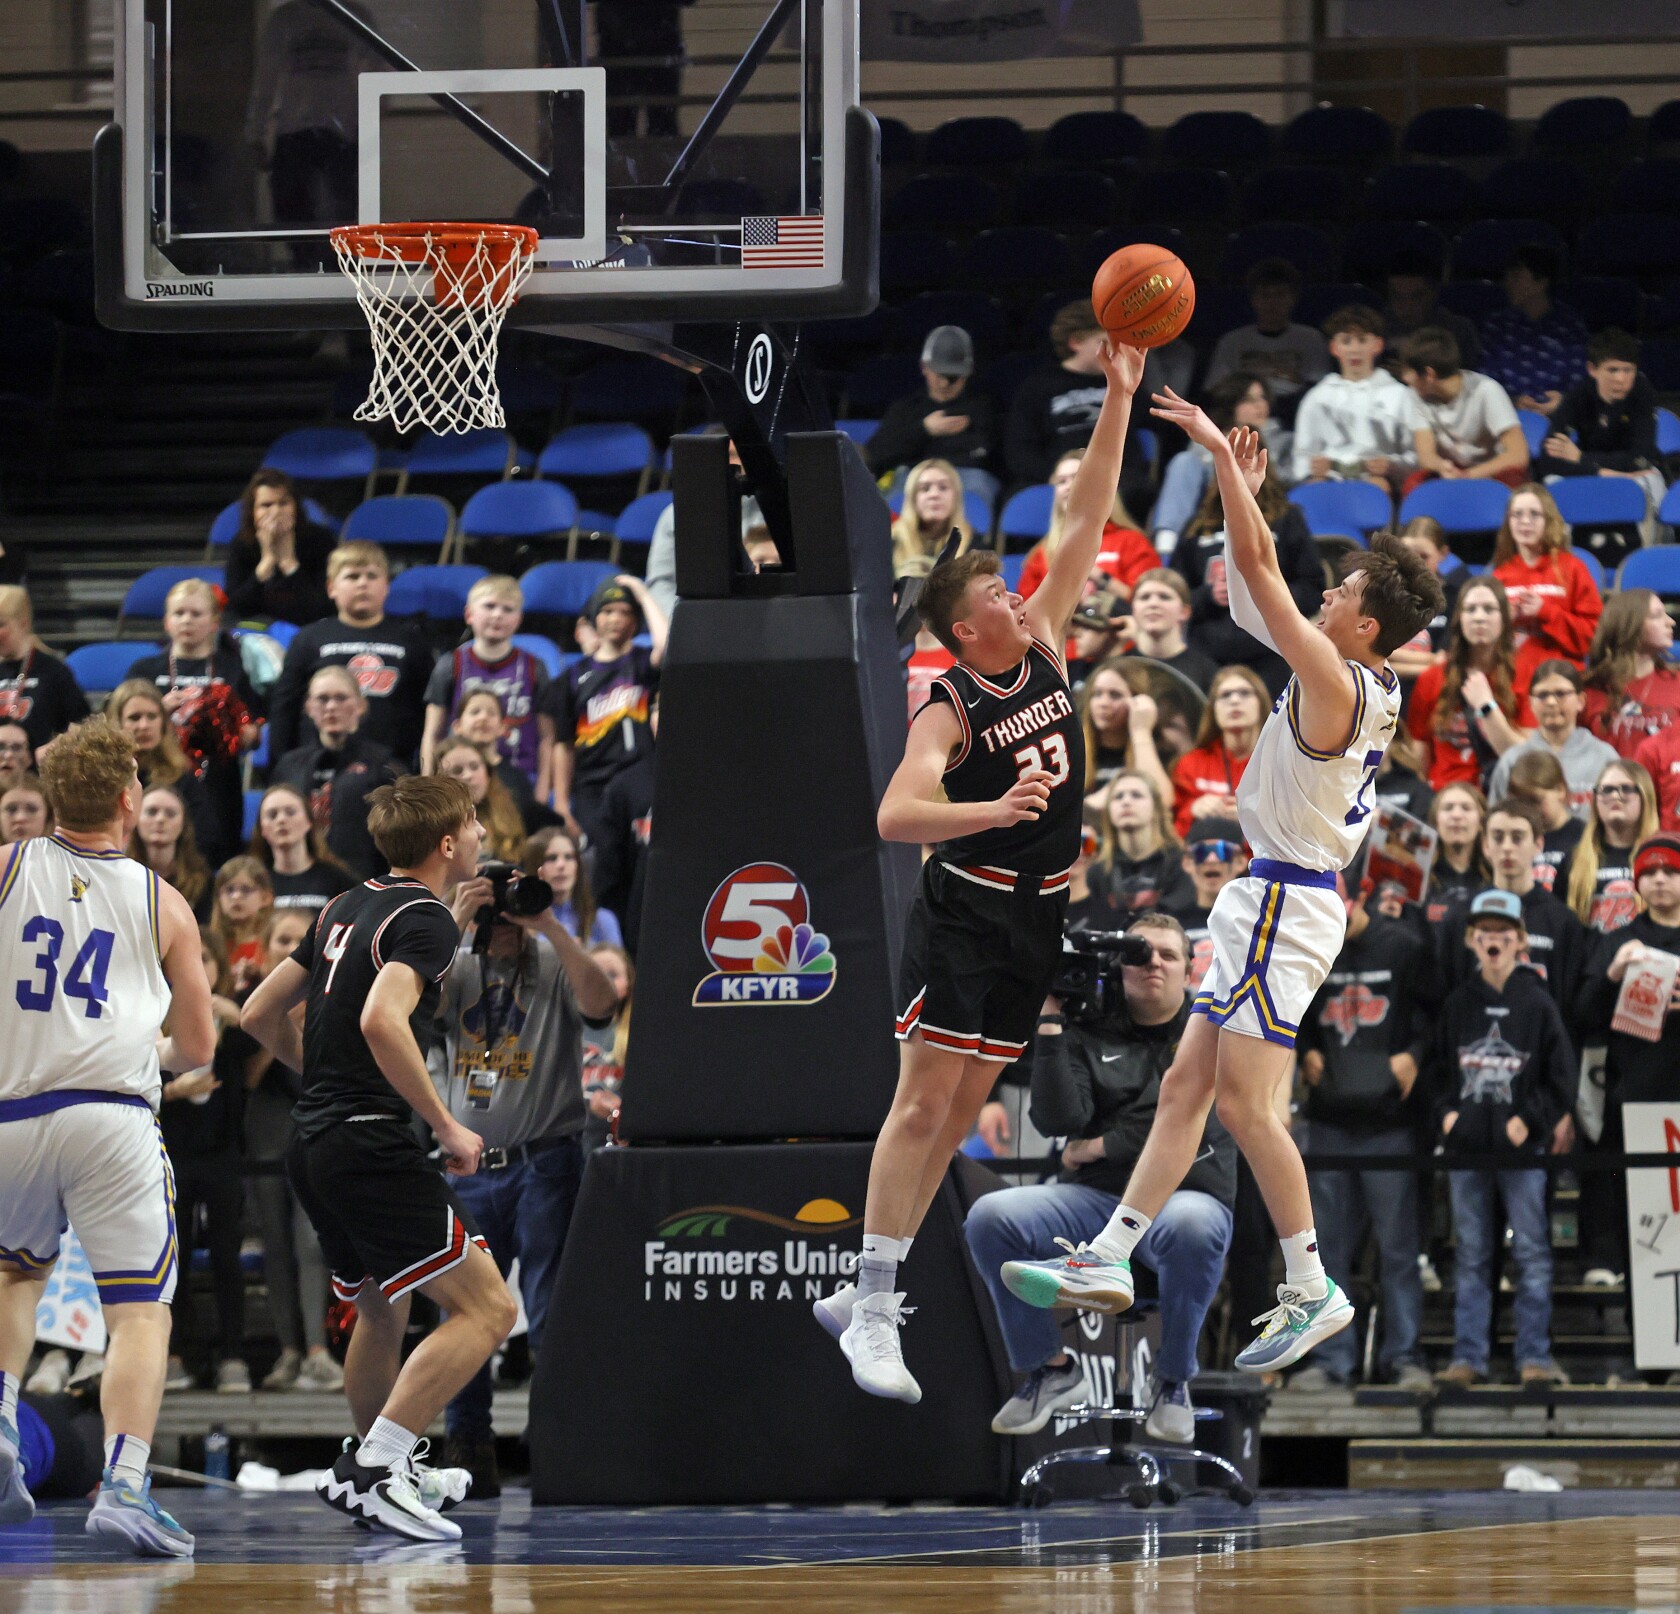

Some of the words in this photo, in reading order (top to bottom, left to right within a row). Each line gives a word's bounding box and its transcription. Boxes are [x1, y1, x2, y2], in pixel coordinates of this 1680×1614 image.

[145, 281, 214, 299] SPALDING
[980, 690, 1073, 753] THUNDER
[1014, 732, 1071, 788] 23
[710, 882, 799, 959] 5
[15, 915, 115, 1019] 34
[322, 922, 355, 995] 4
[721, 976, 799, 1001] KFYR
[644, 1241, 778, 1276] Farmers
[784, 1240, 863, 1276] Unio
